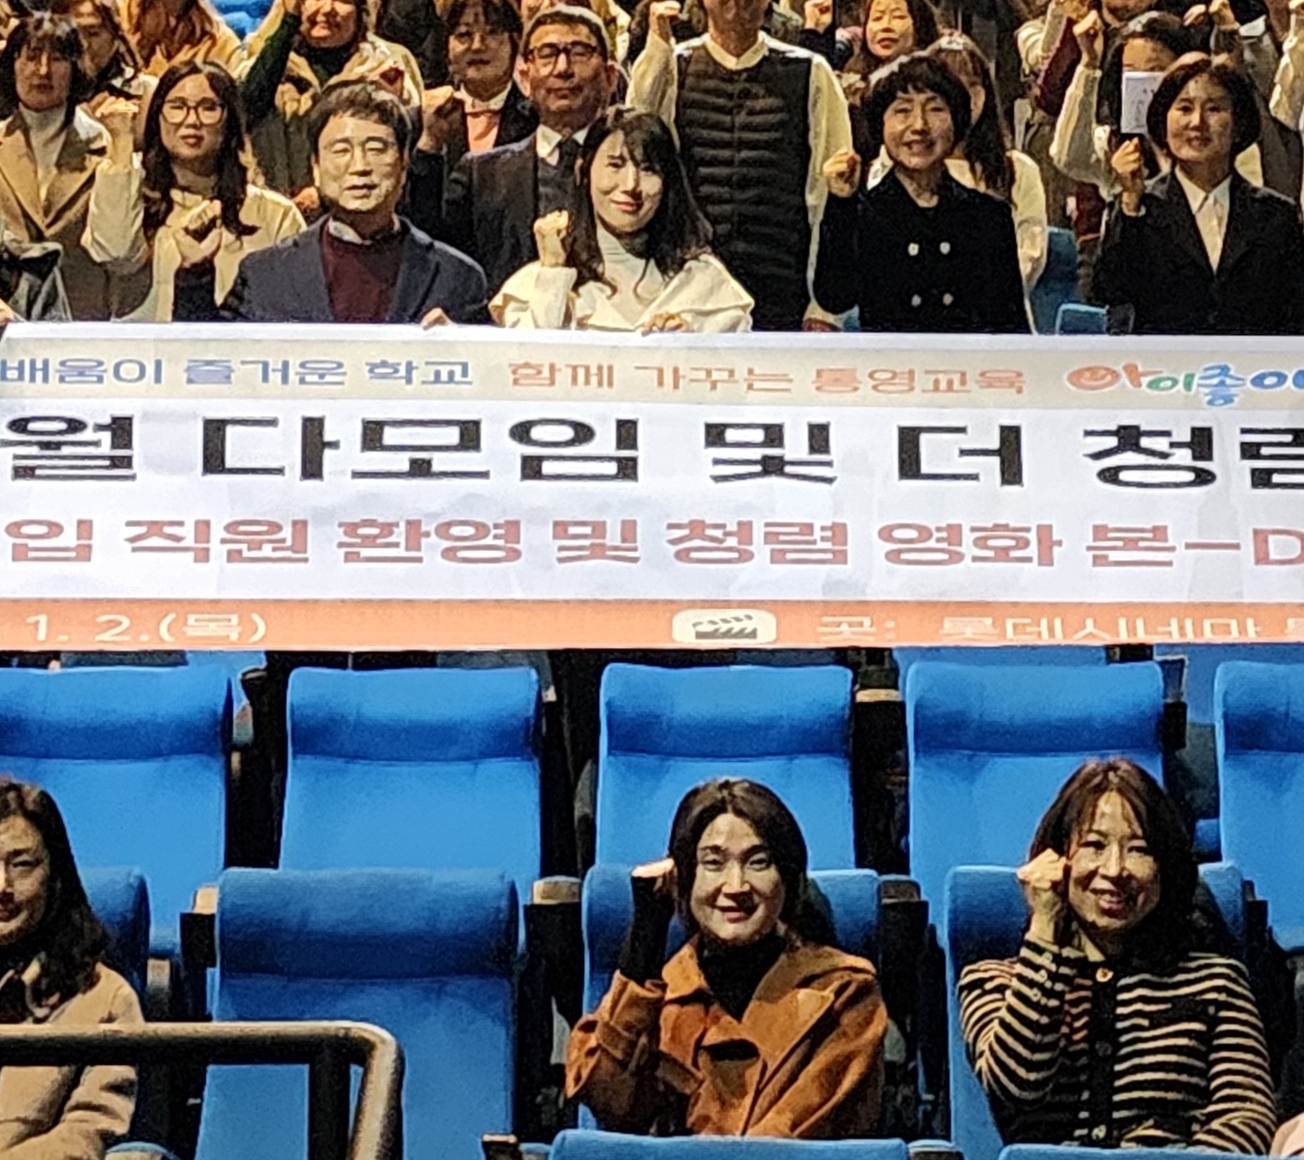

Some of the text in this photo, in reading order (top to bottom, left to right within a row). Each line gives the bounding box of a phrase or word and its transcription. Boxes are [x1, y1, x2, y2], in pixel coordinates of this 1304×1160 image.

[184, 358, 348, 386] 즐거운
[366, 359, 473, 387] 학교
[509, 360, 616, 389] 함께
[635, 363, 793, 393] 가꾸는
[811, 367, 1026, 396] 통영교육
[200, 417, 640, 482] 다모임
[702, 421, 836, 486] 및
[897, 424, 1024, 488] 더
[125, 518, 309, 564] 직원
[338, 518, 520, 565] 환영
[553, 519, 639, 564] 및
[667, 519, 849, 566] 청렴
[878, 522, 1063, 568] 영화
[25, 614, 69, 642] 1.
[94, 612, 268, 645] 2.(목)
[817, 615, 896, 642] 곳:
